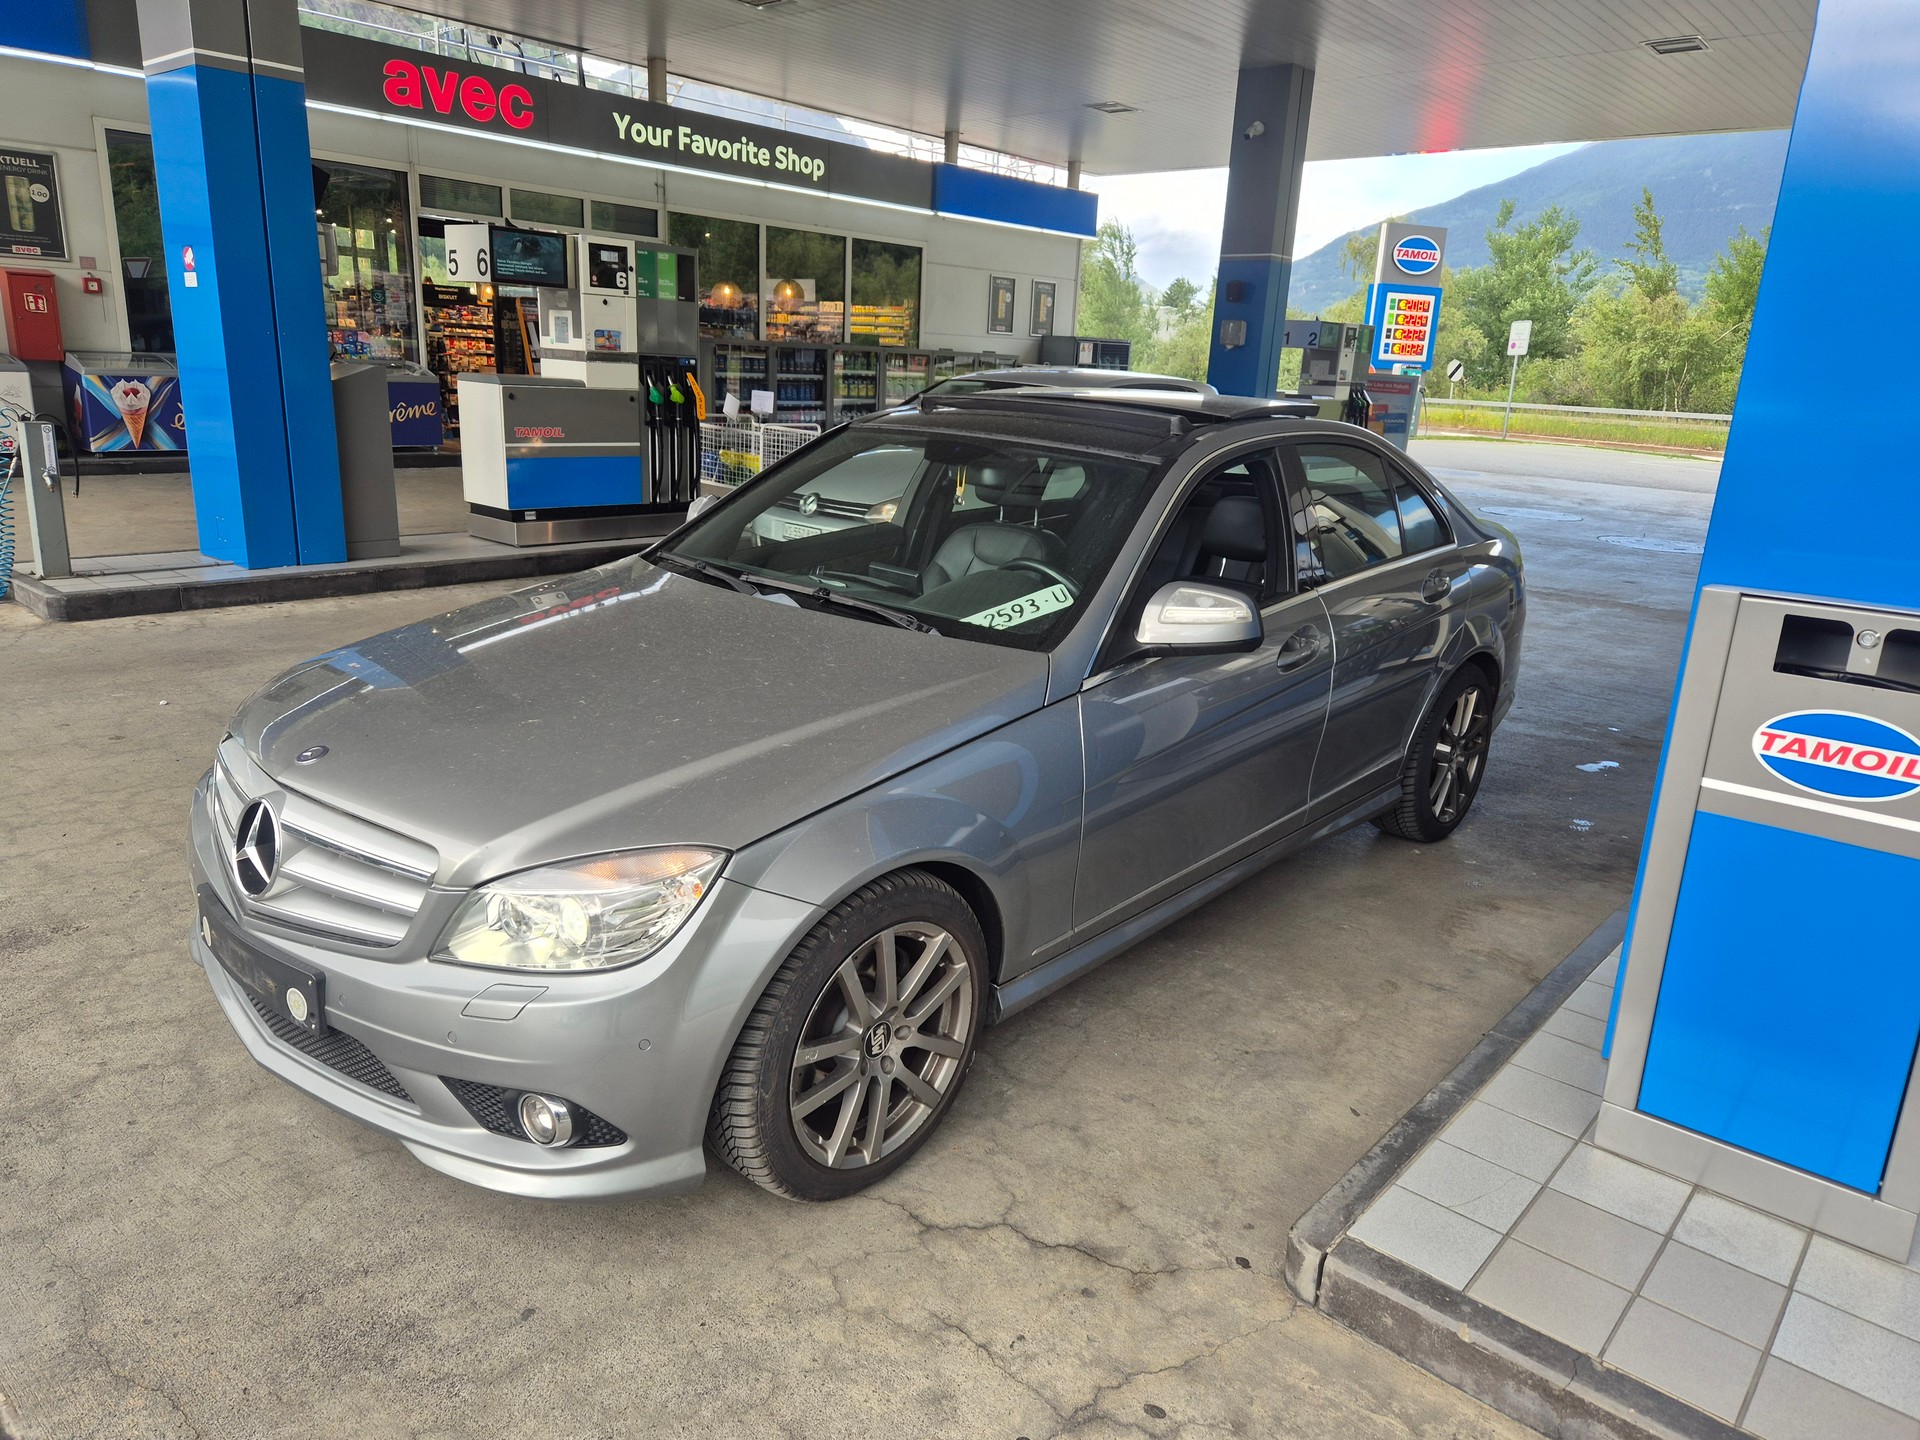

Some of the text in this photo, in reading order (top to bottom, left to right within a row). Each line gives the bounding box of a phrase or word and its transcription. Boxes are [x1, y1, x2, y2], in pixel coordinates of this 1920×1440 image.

[383, 59, 534, 130] avec
[612, 111, 825, 182] Your Favorite Shop
[28, 166, 49, 176] DRINK
[15, 246, 38, 254] avec
[1396, 248, 1438, 261] TAMOIL
[448, 249, 459, 276] 5
[477, 248, 489, 277] 6
[616, 271, 627, 288] 6
[1284, 331, 1318, 346] 1 2
[513, 426, 565, 438] TAMOIL
[1759, 730, 1920, 781] TAMOIL
